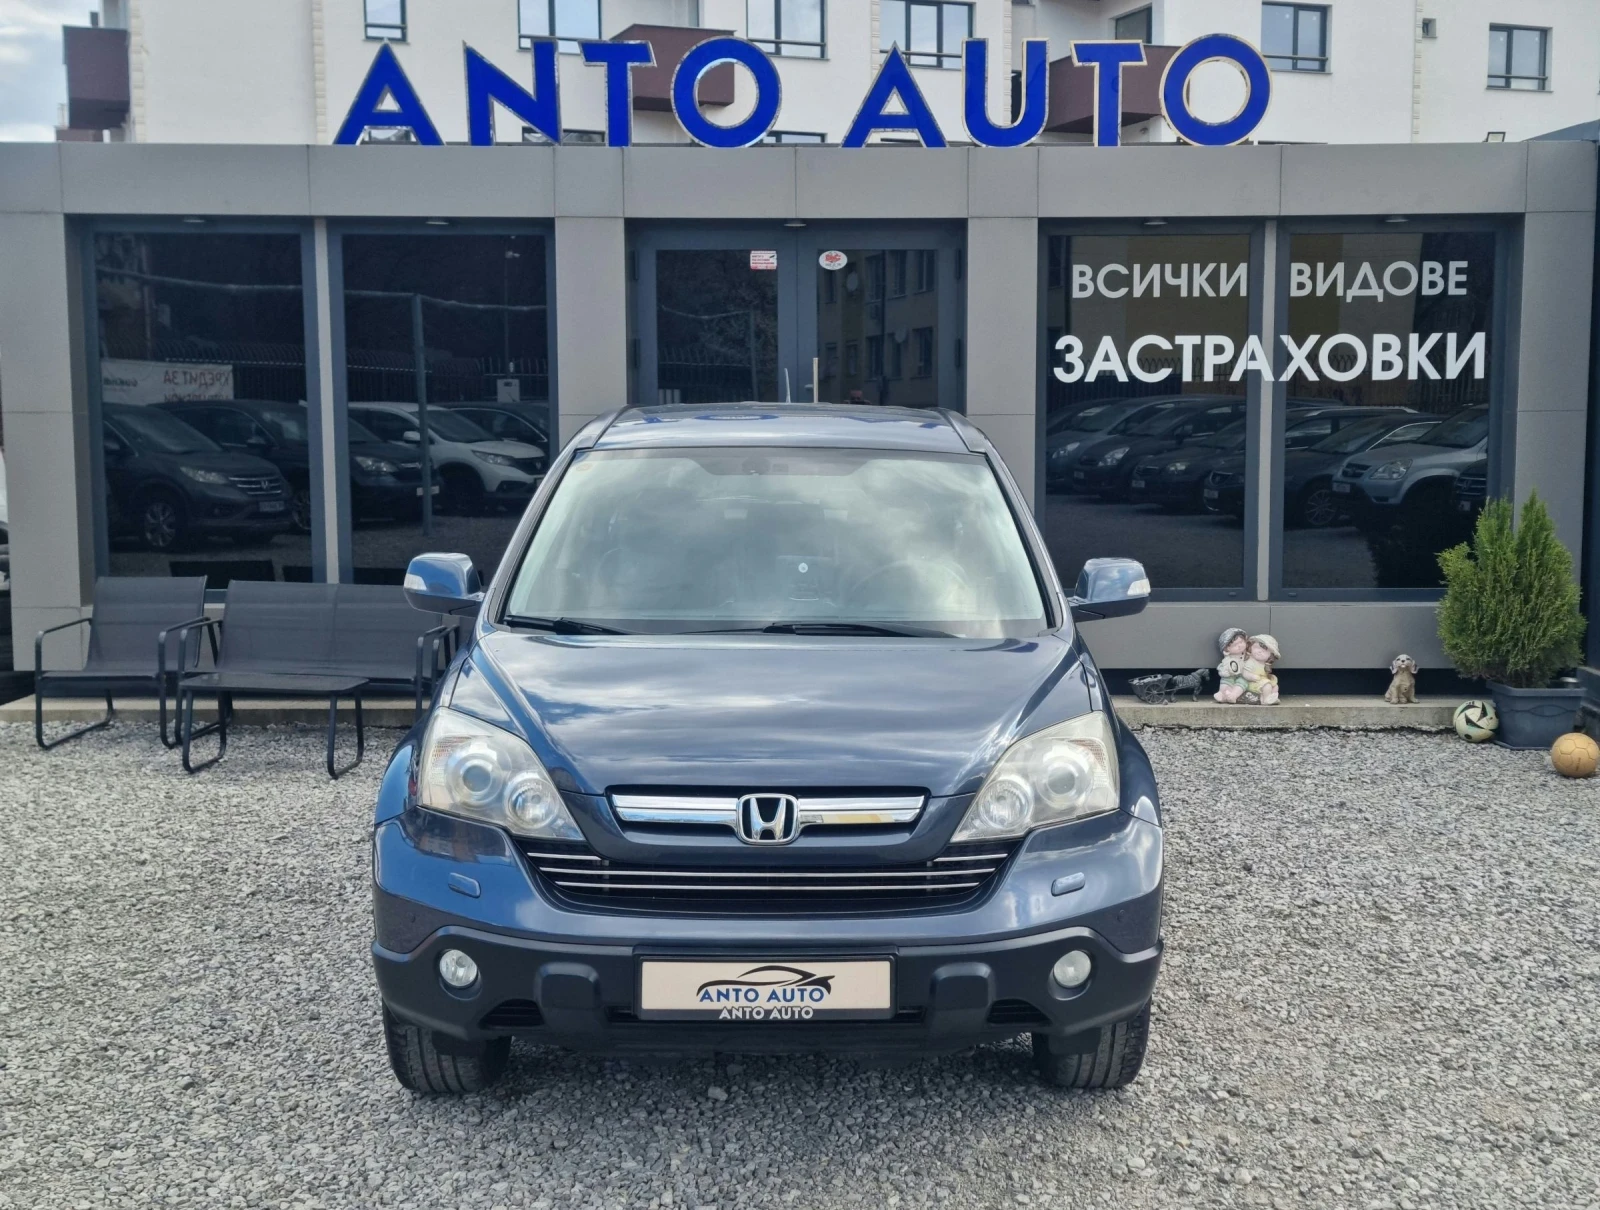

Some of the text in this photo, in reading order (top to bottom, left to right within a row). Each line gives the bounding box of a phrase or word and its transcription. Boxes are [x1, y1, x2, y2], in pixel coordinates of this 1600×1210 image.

[334, 33, 1273, 148] ANTO AUTO
[1072, 260, 1469, 303] ВСИЧКИ ВИДОВЕ
[1053, 332, 1487, 384] ЗАСТРАХОВКИ
[699, 987, 825, 1004] ANTO AUTO
[718, 1006, 814, 1020] ANTO AUTO
